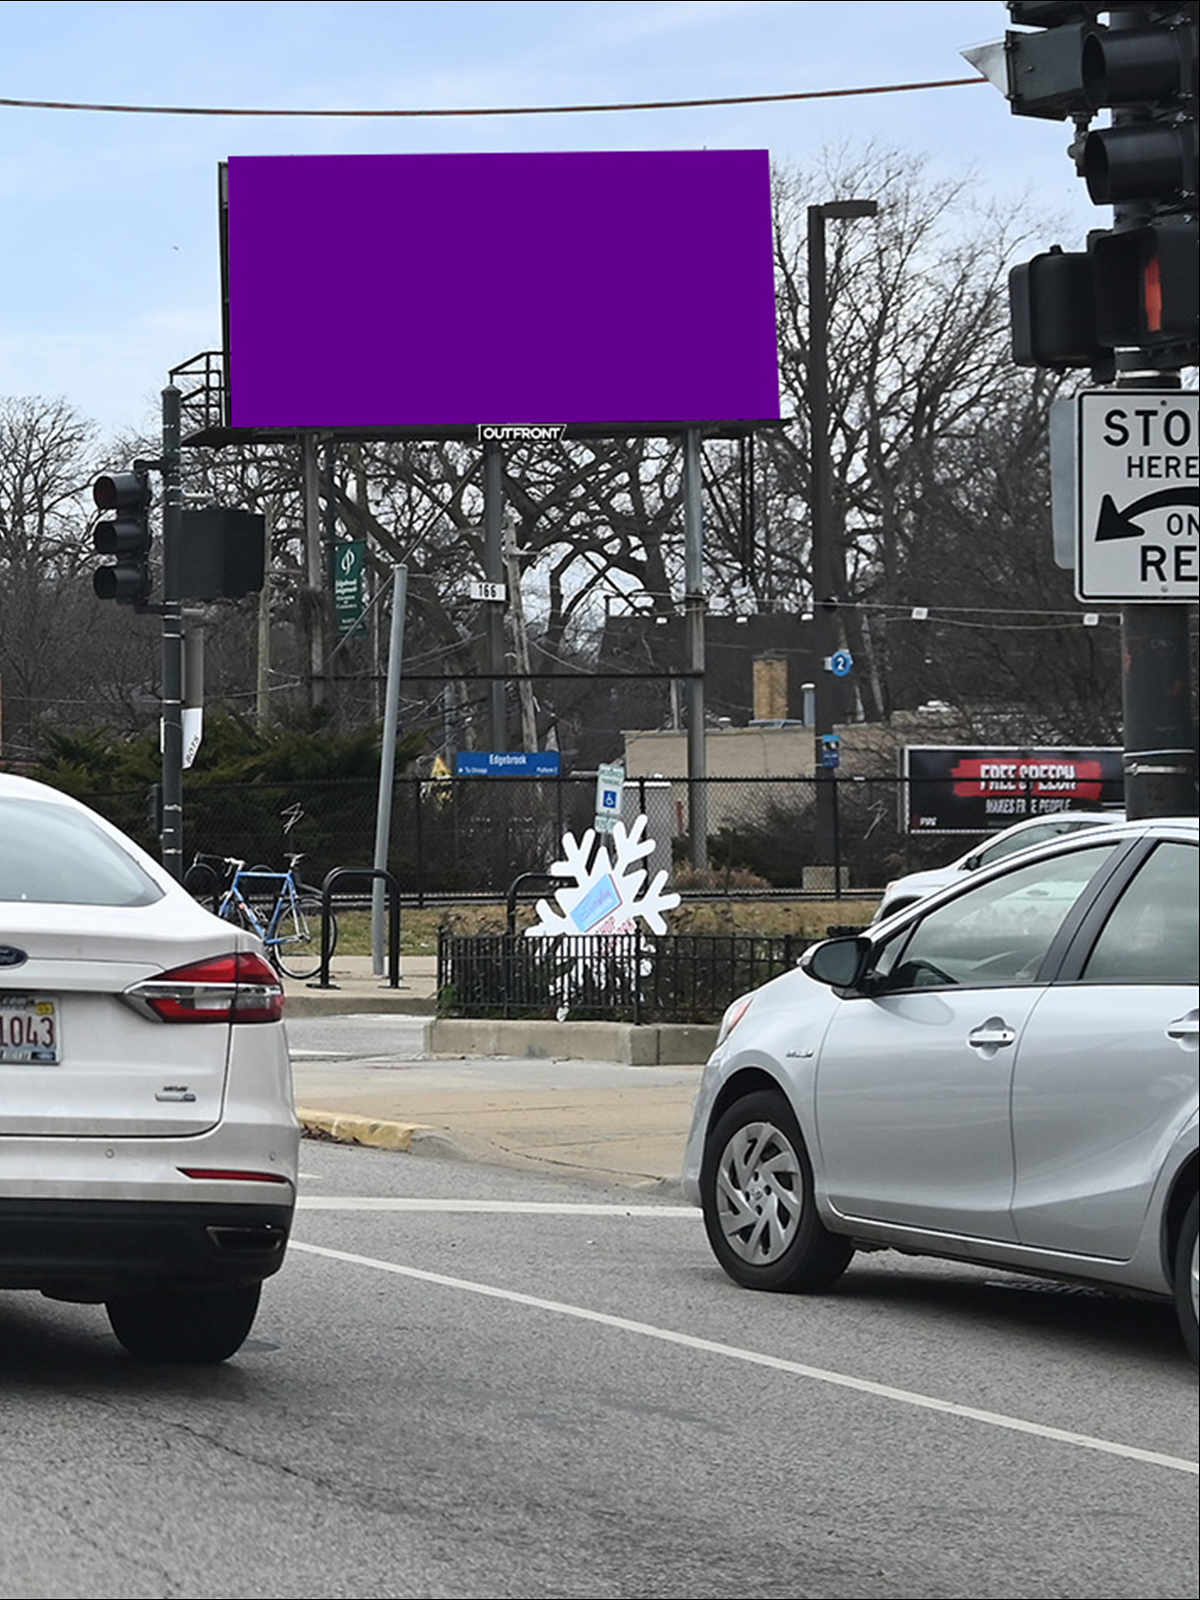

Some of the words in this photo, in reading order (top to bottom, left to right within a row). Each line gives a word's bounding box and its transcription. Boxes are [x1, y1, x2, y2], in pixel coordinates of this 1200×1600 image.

[483, 427, 560, 439] OUTFRONT
[1103, 409, 1199, 446] STO
[1127, 456, 1199, 478] HERE
[1166, 513, 1199, 536] ON
[1140, 545, 1199, 582] RE
[479, 584, 496, 598] 166
[837, 657, 844, 670] 2
[489, 753, 527, 767] Edgebrook
[980, 764, 1016, 791] FREE
[1015, 799, 1037, 814] FRE
